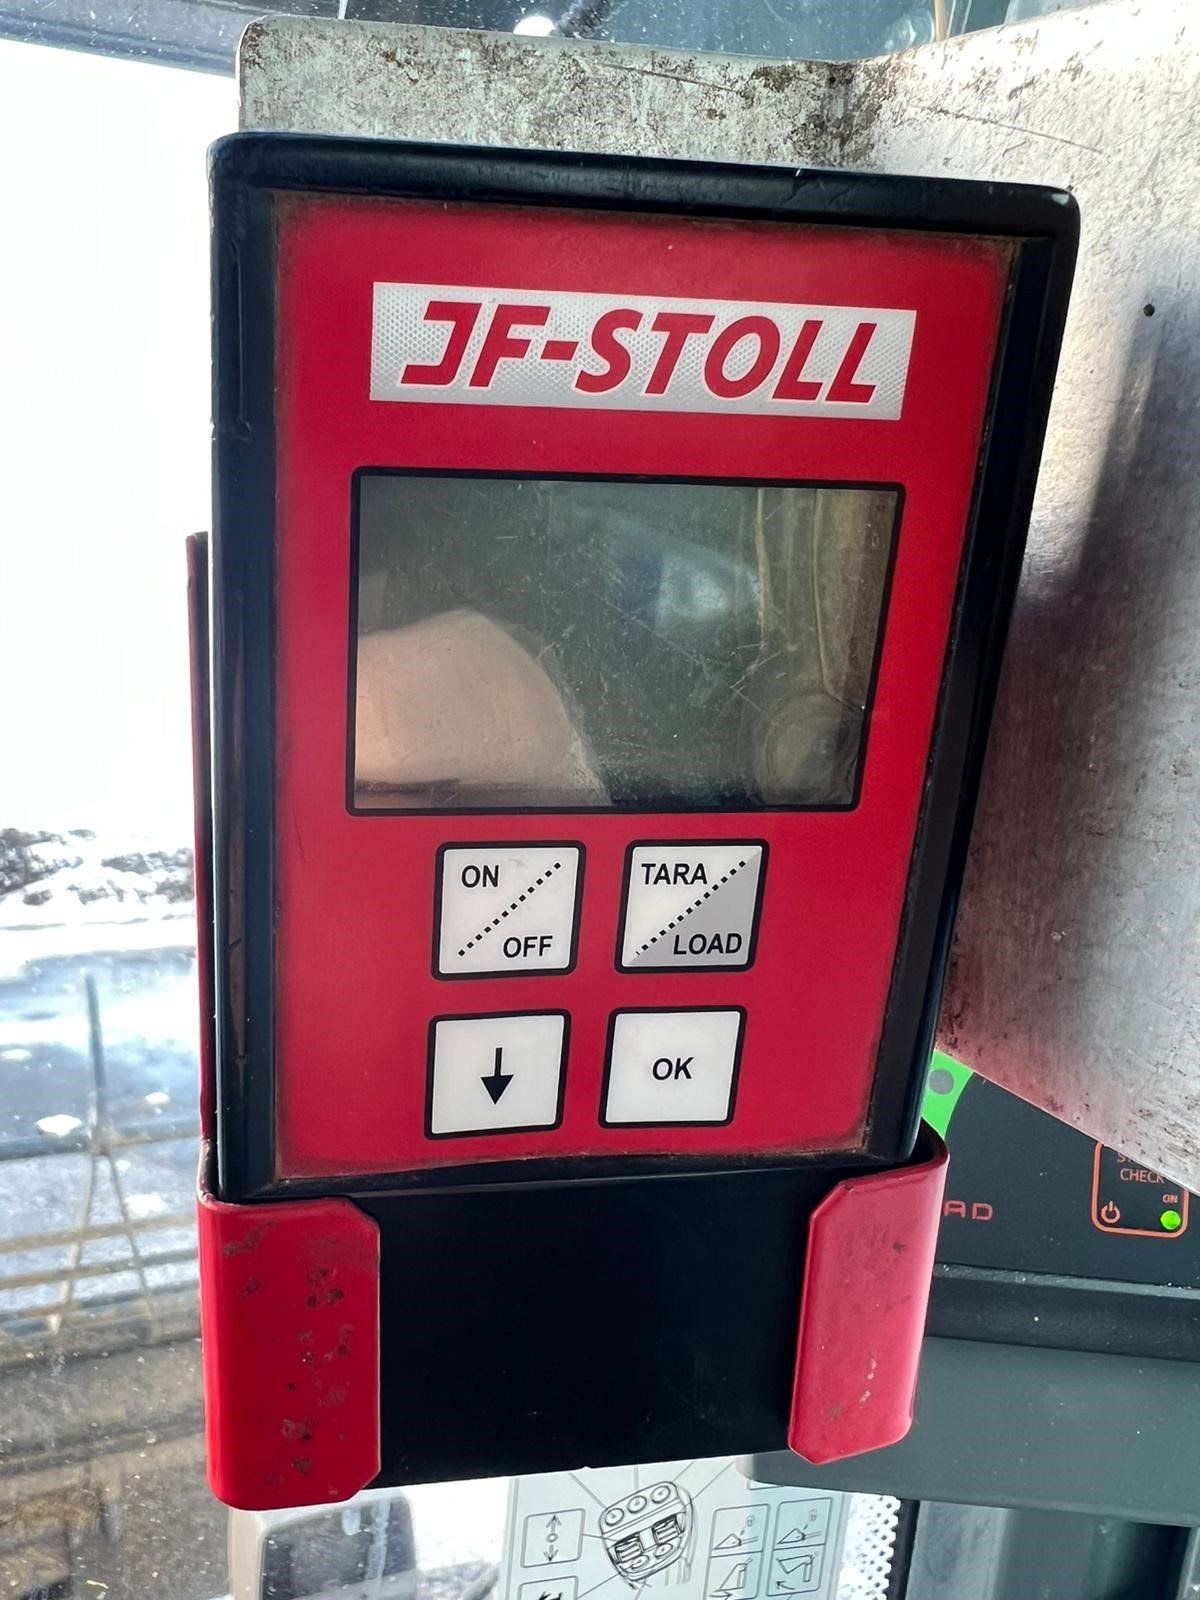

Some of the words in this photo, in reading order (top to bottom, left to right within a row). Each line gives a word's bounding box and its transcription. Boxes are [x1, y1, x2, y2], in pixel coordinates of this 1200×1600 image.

[400, 300, 877, 404] JF-STOLL
[461, 865, 499, 887] ON
[641, 863, 708, 885] TARA
[503, 935, 553, 958] OFF
[673, 933, 742, 955] LOAD
[652, 1056, 694, 1080] OK
[1162, 1194, 1178, 1204] ON
